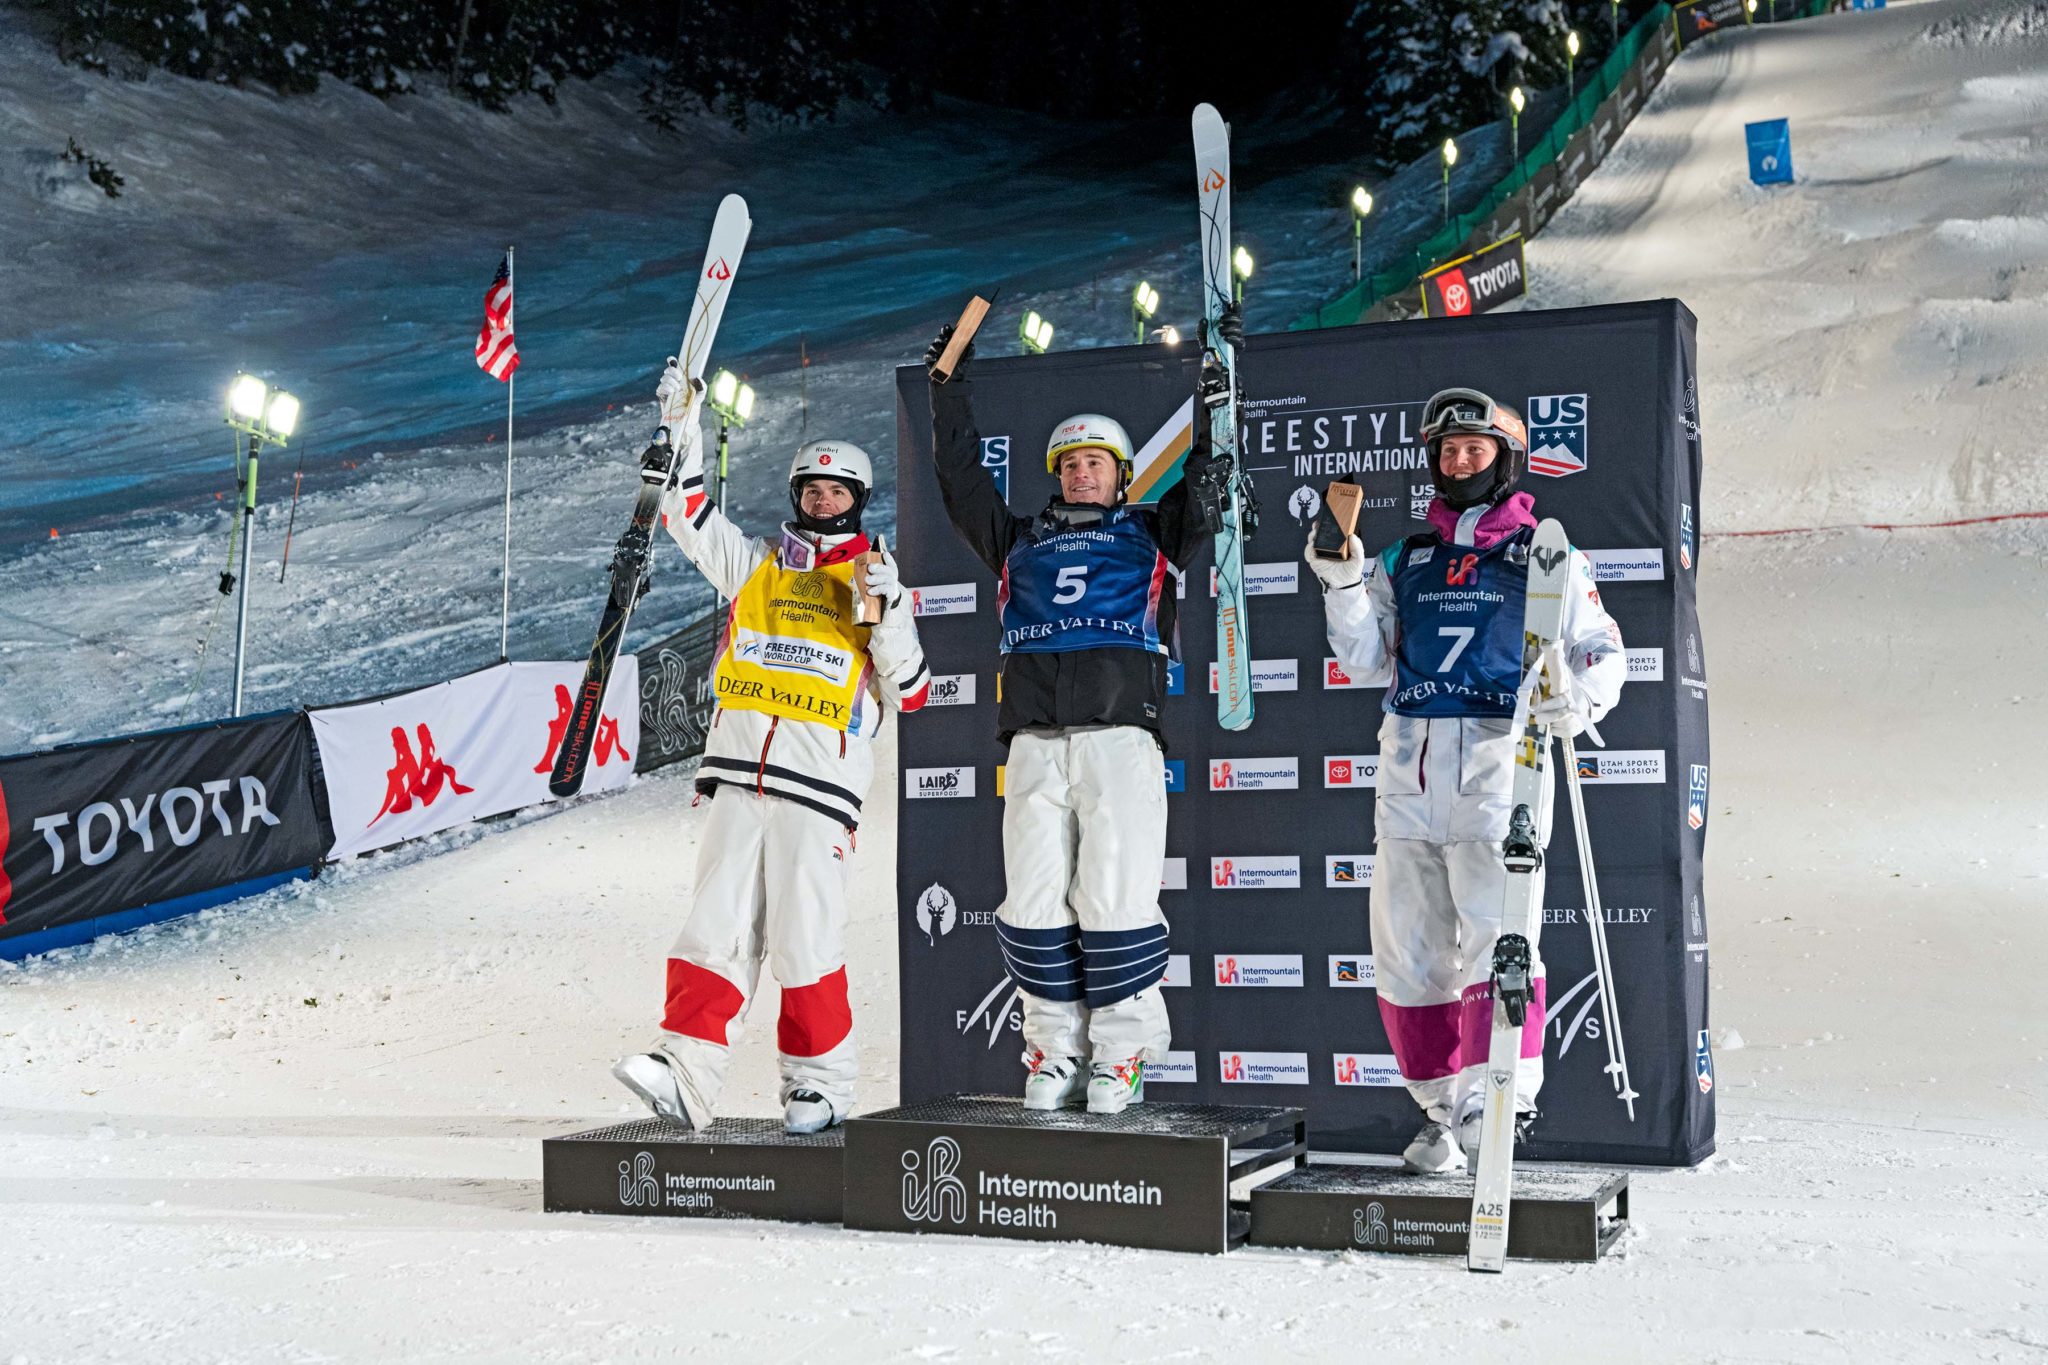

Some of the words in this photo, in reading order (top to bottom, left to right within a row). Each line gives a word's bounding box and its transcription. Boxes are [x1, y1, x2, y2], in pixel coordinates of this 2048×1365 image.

[1468, 258, 1521, 300] TOYOTA
[1242, 395, 1306, 409] ntermountain
[1244, 408, 1268, 418] ealth
[1531, 395, 1586, 426] US
[1294, 447, 1429, 477] INTERNATIONA
[1361, 497, 1397, 510] ALLEY
[1055, 540, 1090, 553] Health
[1595, 561, 1661, 570] Intermountain
[1245, 574, 1296, 584] termountain
[1596, 570, 1625, 579] Health
[1052, 565, 1088, 605] 5
[1245, 585, 1263, 593] ealth
[925, 595, 974, 606] Intermountain
[1417, 590, 1505, 603] Intermountain
[925, 605, 947, 613] Health
[1439, 601, 1478, 613] Health
[780, 610, 815, 624] Health
[765, 642, 824, 660] FREESTYLE
[824, 653, 844, 667] SKI
[1436, 627, 1476, 673] 7
[764, 651, 793, 662] WORLD
[794, 656, 812, 665] CUP
[718, 675, 764, 698] DEER
[771, 686, 845, 721] VALLEY
[1600, 759, 1623, 767] UTAH
[1626, 759, 1659, 767] SPORTS
[1237, 770, 1295, 779] Intermountain
[1601, 767, 1659, 775] COMMISSION
[1237, 779, 1263, 788] Health
[1691, 766, 1707, 790] US
[33, 775, 281, 875] TOYOTA
[1239, 868, 1297, 878] Intermountain
[1239, 877, 1265, 887] Health
[1541, 909, 1578, 924] EER
[1242, 967, 1301, 976] Intermountain
[1243, 976, 1268, 984] Health
[1142, 1063, 1194, 1071] ntermountain
[1247, 1064, 1306, 1073] Intermountain
[1363, 1066, 1402, 1076] Intermou
[1248, 1073, 1274, 1081] Health
[1364, 1075, 1391, 1084] Health
[665, 1172, 775, 1191] Intermountain
[978, 1170, 1162, 1206] Intermountain
[666, 1191, 714, 1208] Health
[978, 1200, 1057, 1229] Health
[1476, 1203, 1504, 1217] A25
[1393, 1218, 1469, 1233] Intermount
[1394, 1232, 1435, 1247] Health
